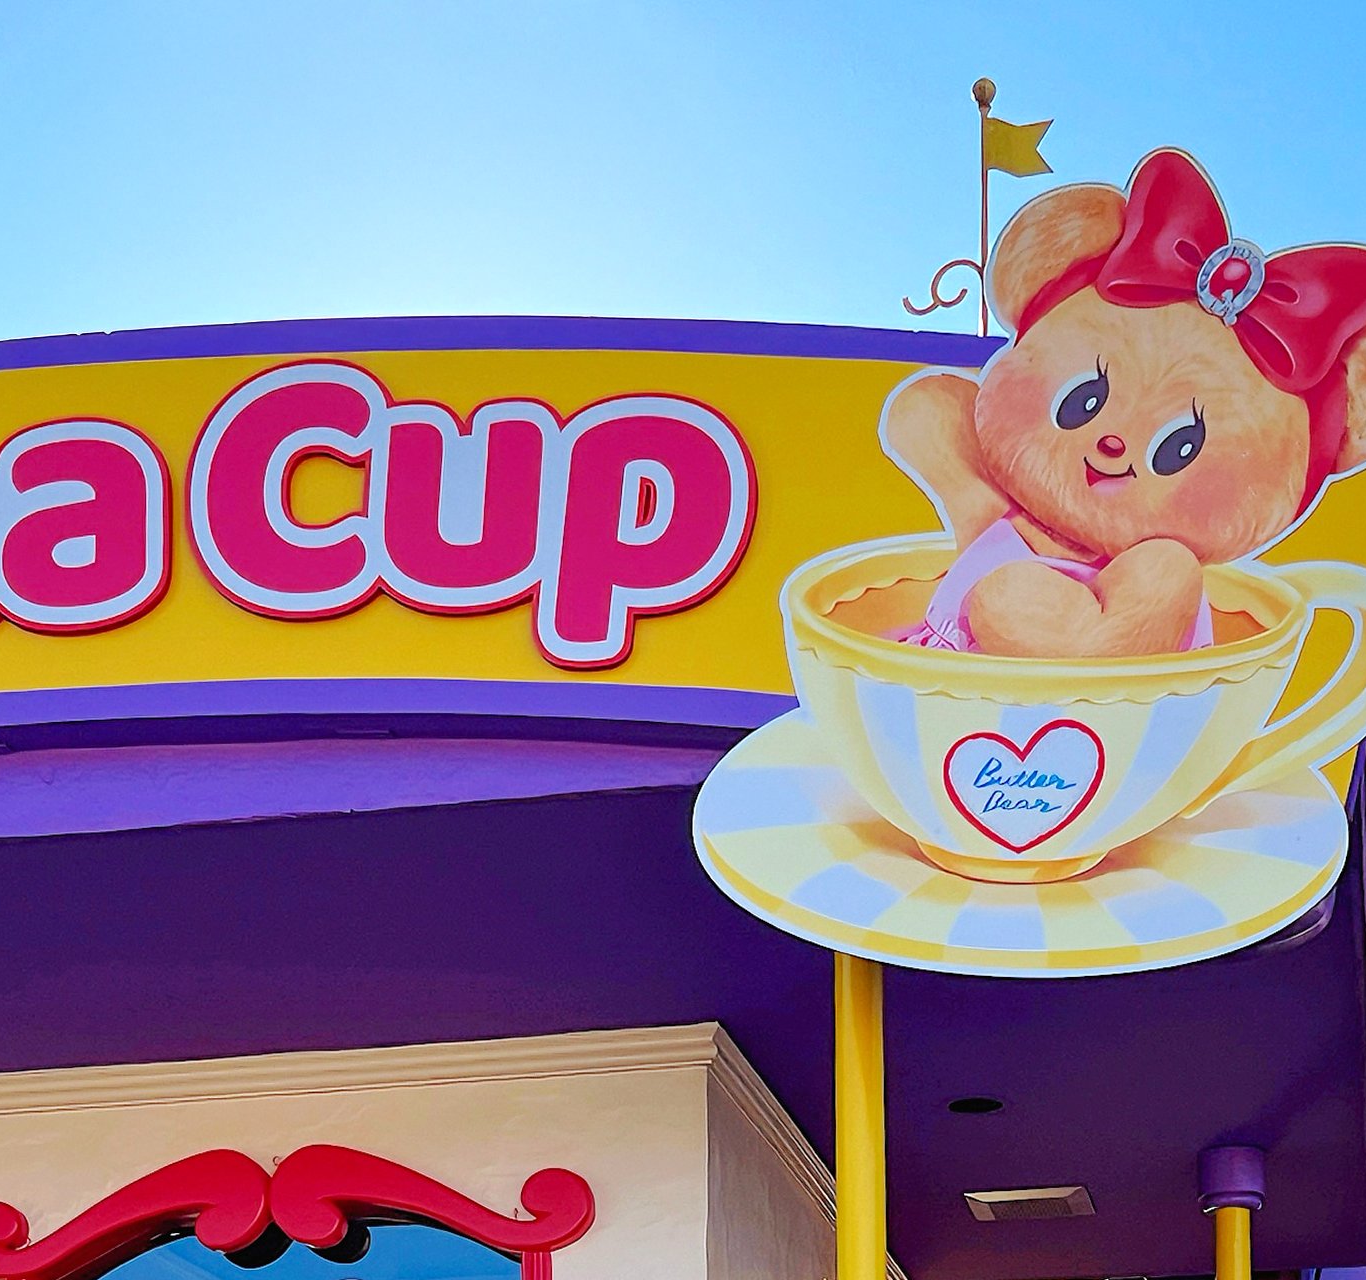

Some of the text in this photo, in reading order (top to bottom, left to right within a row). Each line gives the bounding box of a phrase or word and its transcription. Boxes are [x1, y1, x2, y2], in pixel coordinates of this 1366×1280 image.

[188, 359, 758, 670] Cup
[973, 757, 1076, 790] Butter
[981, 790, 1062, 813] Bear
